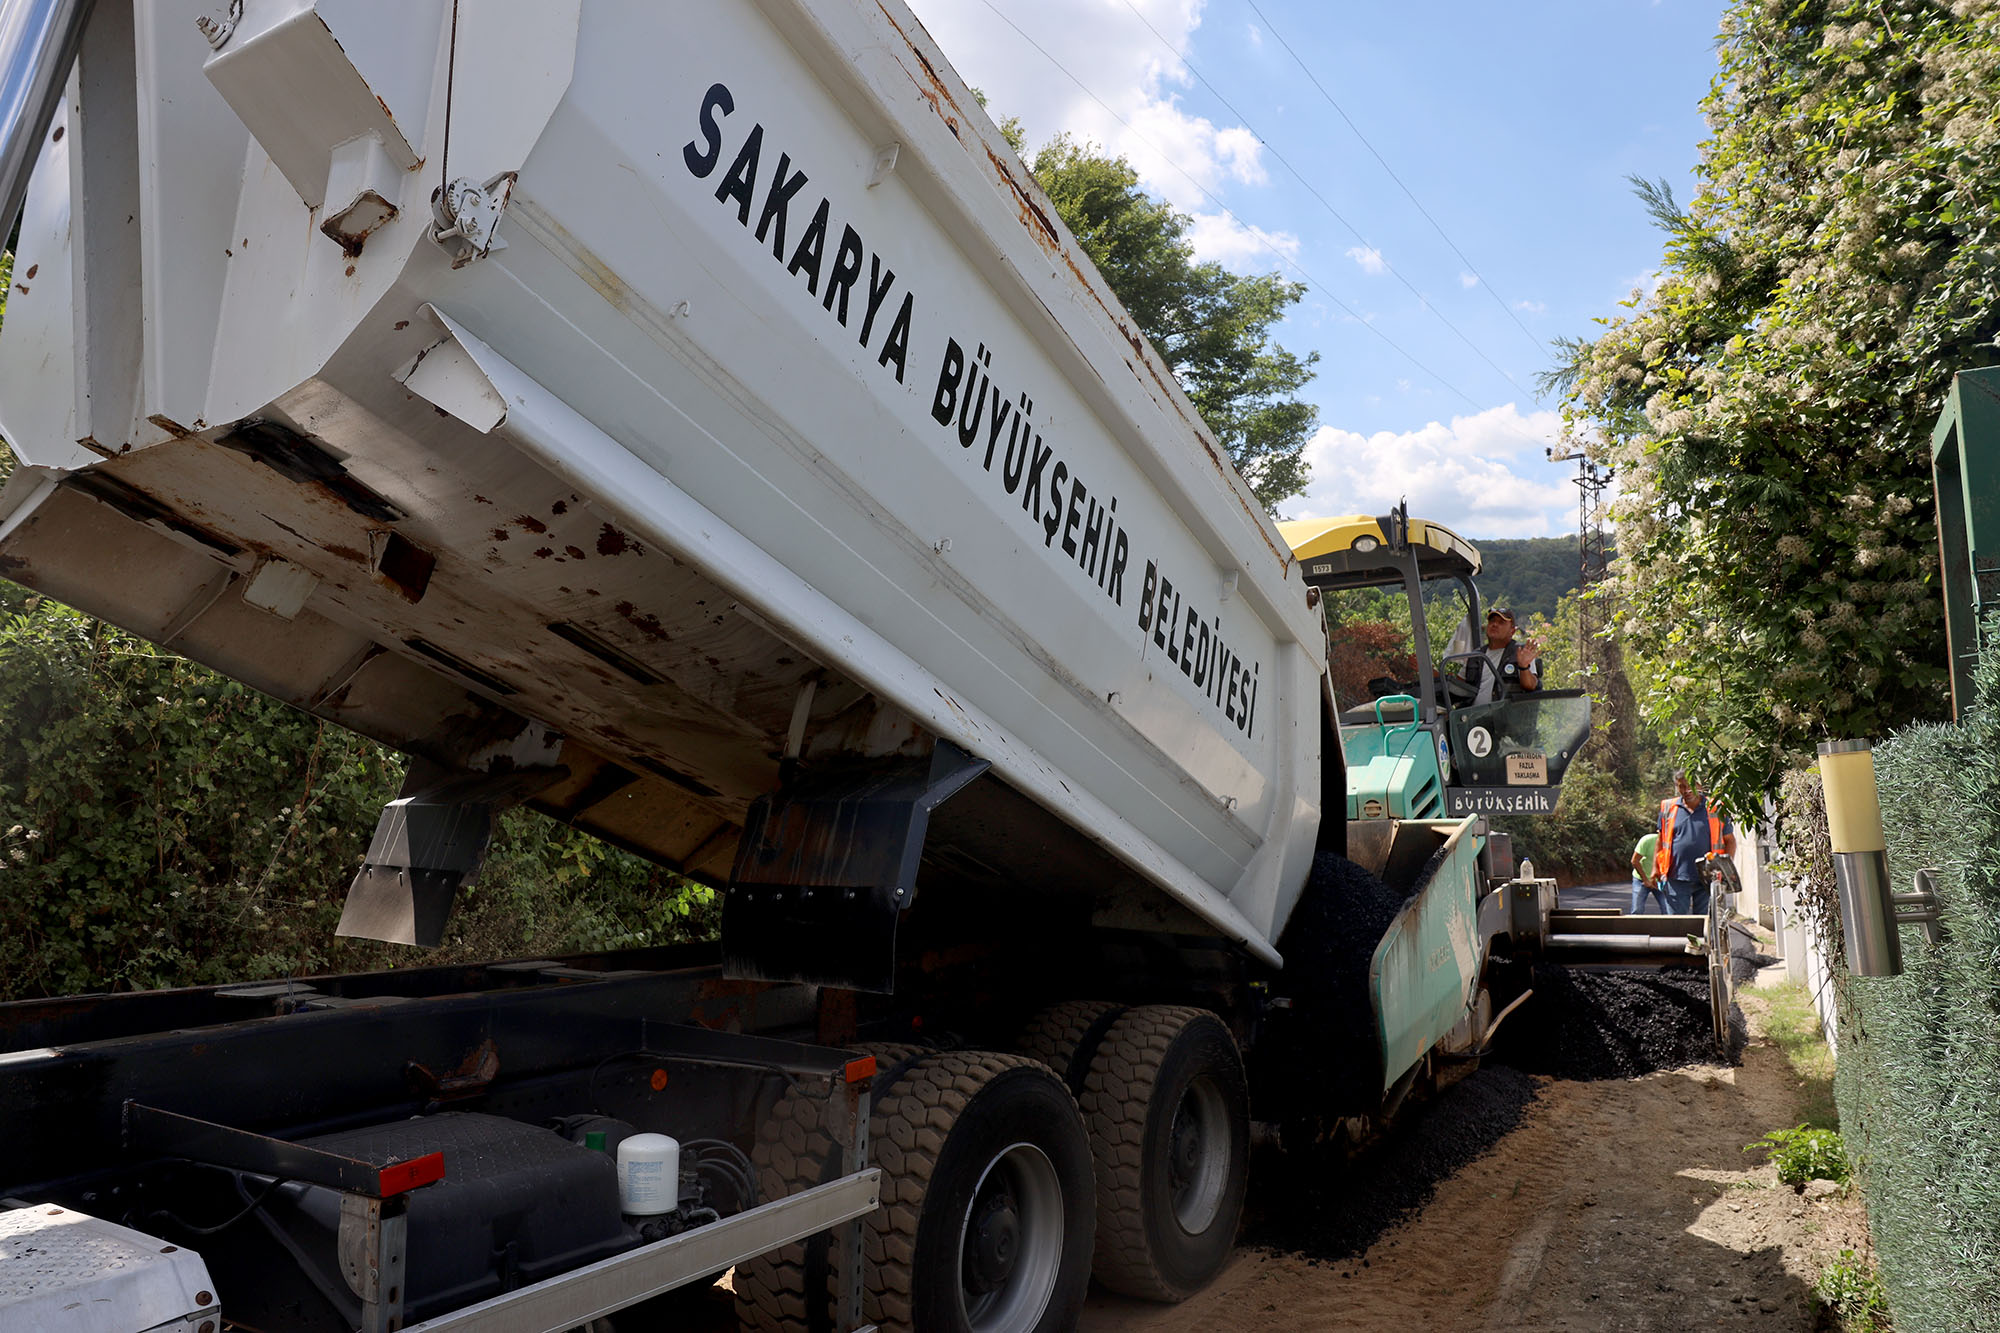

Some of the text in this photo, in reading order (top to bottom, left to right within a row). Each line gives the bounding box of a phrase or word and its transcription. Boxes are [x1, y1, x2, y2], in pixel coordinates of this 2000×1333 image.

[683, 83, 1260, 740] SAKARYA BÜYÜKŞEHİR BELEDİYESİ
[1314, 565, 1330, 573] 1573
[1473, 730, 1487, 754] 2
[1455, 790, 1549, 812] BÜYÜKŞEHİR
